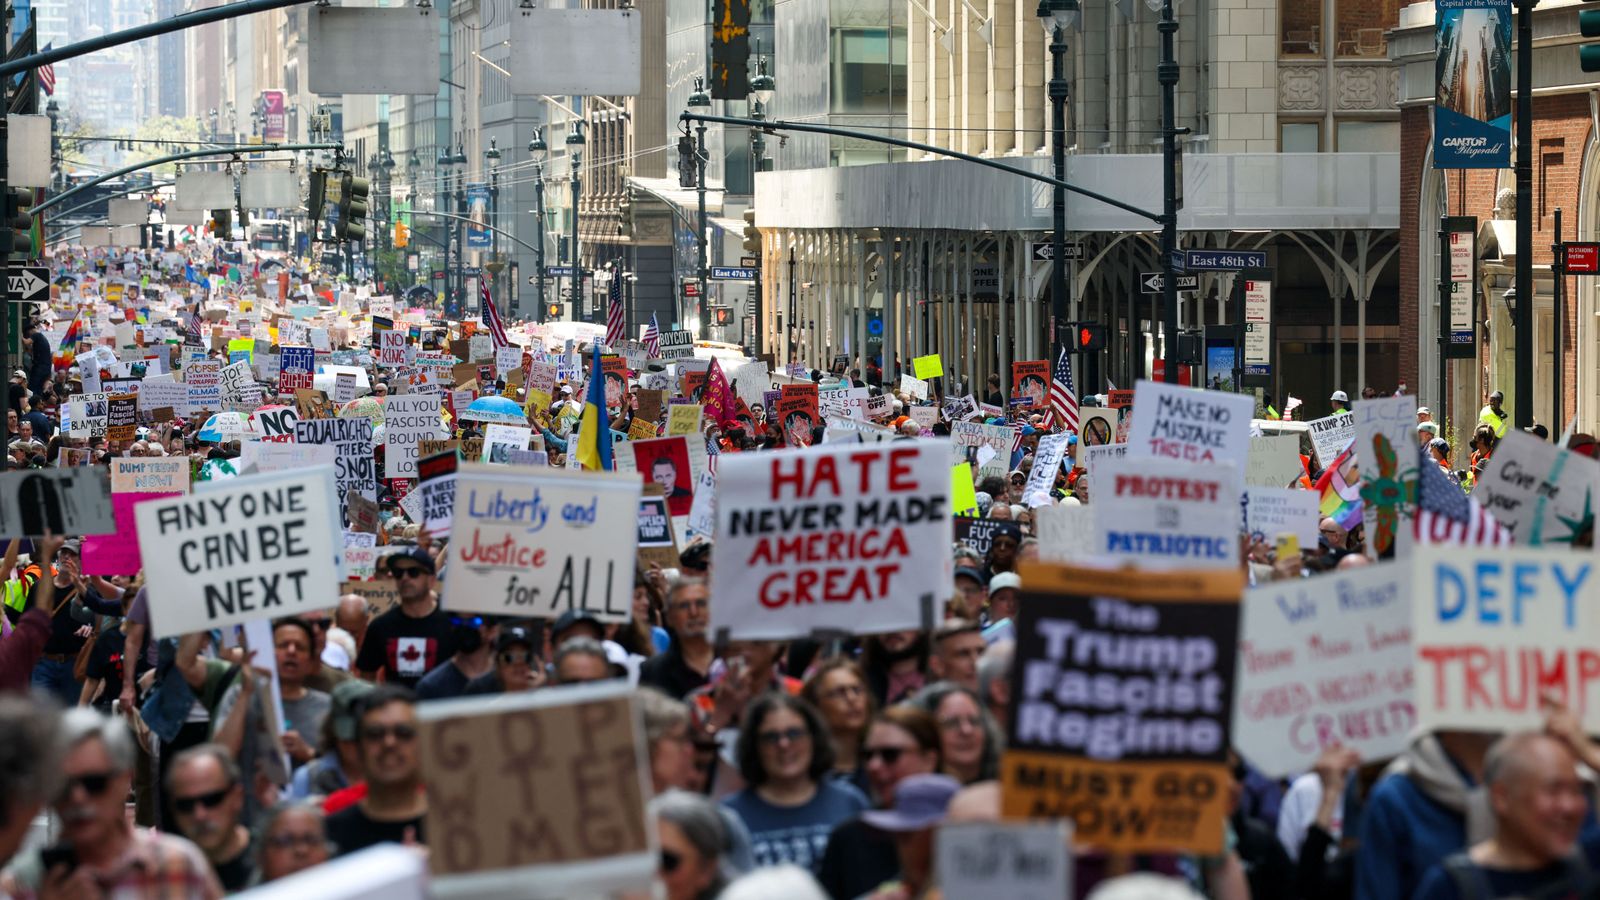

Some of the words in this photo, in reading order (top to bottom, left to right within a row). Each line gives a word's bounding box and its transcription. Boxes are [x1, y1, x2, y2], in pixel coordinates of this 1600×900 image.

[1440, 0, 1463, 8] Capital
[1442, 137, 1487, 147] CANTOR
[1454, 142, 1501, 159] Fitzgerald
[1042, 247, 1053, 256] ON
[1191, 254, 1217, 266] East
[1219, 255, 1245, 267] 48th
[1247, 256, 1260, 268] St
[715, 269, 731, 277] East
[732, 270, 748, 278] 47th
[1152, 278, 1164, 287] ON
[1246, 323, 1252, 332] 6
[386, 333, 404, 346] NO
[660, 330, 693, 345] BOYCOTT
[281, 353, 313, 370] FIGHT
[661, 348, 695, 359] EVERYTHING
[280, 373, 313, 389] RIGHTS
[70, 394, 90, 402] TIME
[92, 393, 105, 401] TO
[188, 387, 219, 396] KILMAR
[866, 395, 885, 403] HANDS
[111, 404, 134, 413] Trump
[386, 401, 409, 413] ALL
[411, 400, 439, 412] YOU
[867, 401, 886, 411] OFF!
[1157, 393, 1206, 423] MAKE
[1208, 404, 1231, 425] NO
[1359, 401, 1413, 424] ICE
[109, 411, 135, 419] Fascist
[109, 418, 135, 427] Regime
[259, 409, 297, 436] NO
[385, 415, 441, 428] FASCISTS
[71, 418, 107, 431] BLAMING
[952, 422, 984, 434] AMERICA
[1310, 417, 1338, 434] TRUMP
[1339, 413, 1354, 428] STO
[90, 427, 108, 437] BIDE
[389, 432, 435, 445] BOUND
[1151, 418, 1228, 448] MISTAKE
[336, 441, 373, 456] THERS
[423, 440, 448, 454] HAVE
[462, 441, 481, 453] SOM
[958, 433, 1006, 450] STRONGER
[1149, 438, 1181, 460] THIS
[1183, 444, 1198, 462] IS
[1200, 449, 1216, 464] A
[119, 462, 146, 474] DUMP
[347, 455, 374, 480] NOT
[770, 447, 922, 501] HATE
[1114, 474, 1221, 502] PROTEST
[1500, 459, 1531, 492] Give
[1536, 481, 1561, 501] me
[1252, 496, 1288, 506] LIBERTY
[1484, 488, 1523, 512] your
[157, 484, 309, 536] ANYONE
[423, 504, 456, 521] PART
[468, 486, 554, 534] Liberty
[561, 493, 599, 525] and
[729, 503, 840, 538] NEVER
[855, 497, 947, 529] MADE
[1272, 506, 1308, 517] JUSTICE
[640, 526, 665, 538] TRUMP
[969, 525, 995, 540] FUC
[179, 526, 251, 576] CAN
[257, 518, 310, 562] BE
[459, 527, 548, 570] Justice
[747, 526, 911, 568] AMERICA
[960, 537, 990, 553] TRU
[1105, 529, 1229, 560] PATRIOTIC
[504, 574, 542, 607] for
[550, 554, 628, 617] ALL
[758, 563, 901, 610] GREAT
[203, 568, 309, 621] NEXT
[1434, 558, 1593, 631] DEFY
[1090, 597, 1161, 632] The
[1035, 617, 1219, 676] Trump
[1022, 658, 1225, 714] Fascist
[1416, 645, 1600, 715] TRUMP
[430, 702, 618, 771] GOP
[1013, 700, 1223, 762] Regime
[1015, 762, 1141, 798] MUST
[1153, 770, 1220, 804] GO
